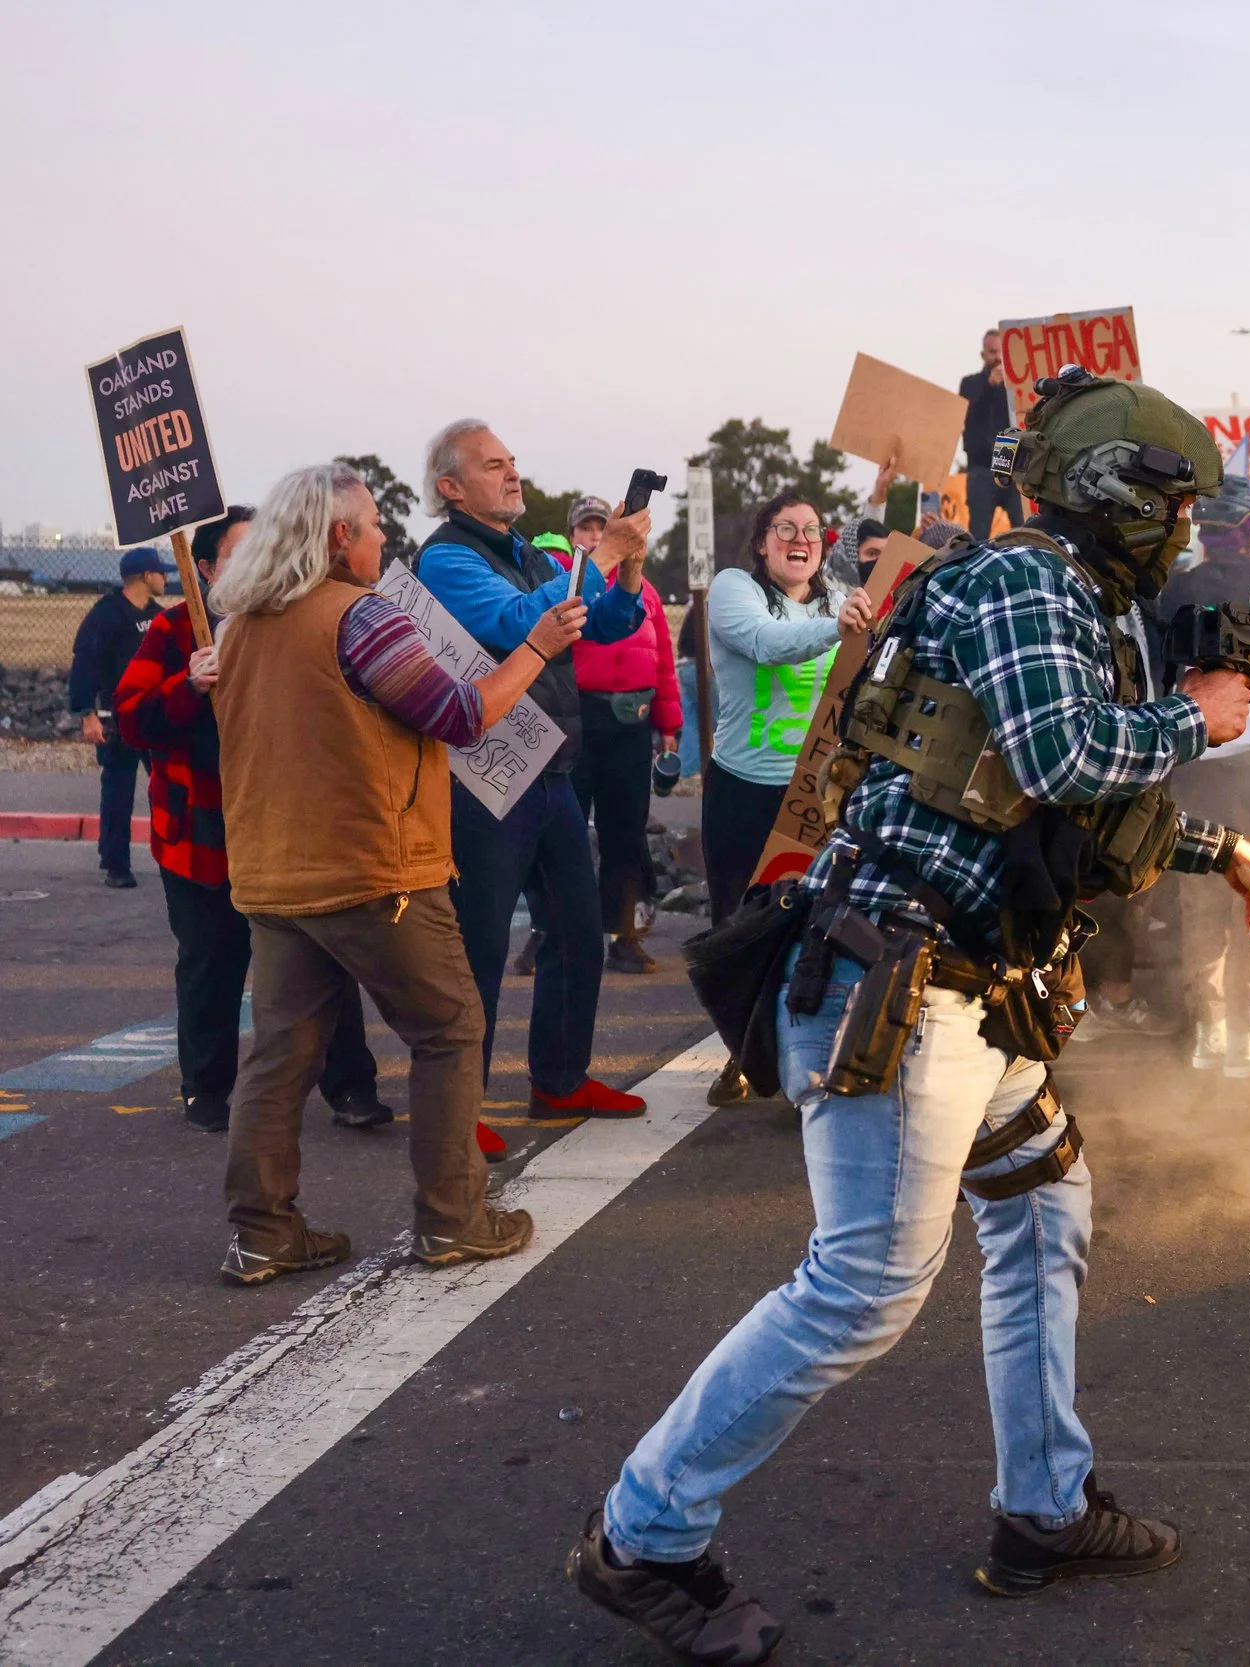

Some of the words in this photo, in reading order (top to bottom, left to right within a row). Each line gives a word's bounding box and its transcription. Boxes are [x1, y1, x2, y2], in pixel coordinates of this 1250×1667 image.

[100, 350, 178, 395] OAKLAND
[1002, 315, 1138, 385] CHINGA
[114, 379, 174, 420] STANDS
[115, 409, 193, 472] UNITED
[127, 459, 199, 502] AGAINST
[150, 493, 189, 524] HATE
[380, 573, 432, 641] ALL
[436, 636, 461, 669] you
